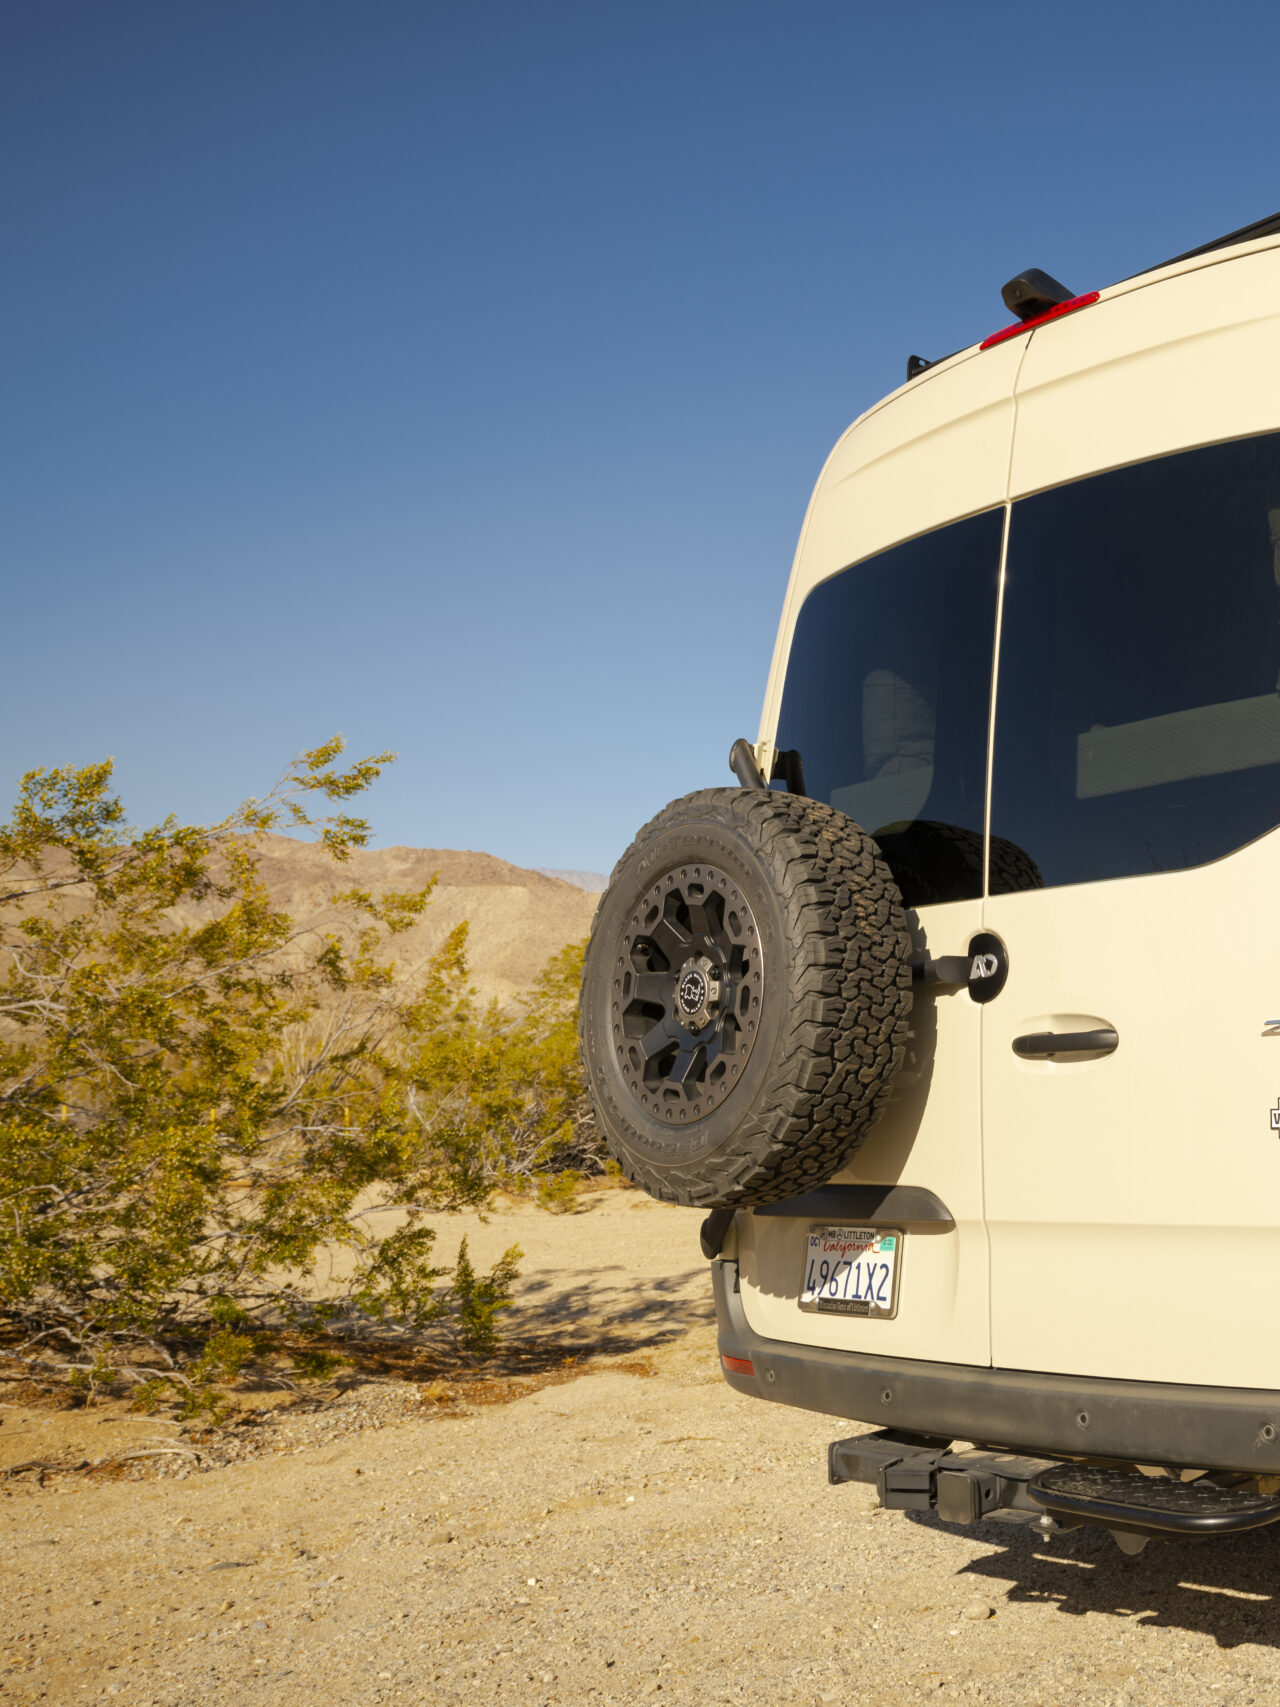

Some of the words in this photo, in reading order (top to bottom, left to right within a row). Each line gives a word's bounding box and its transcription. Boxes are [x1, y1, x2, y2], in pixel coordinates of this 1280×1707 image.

[843, 1231, 875, 1240] LITTLETON
[823, 1240, 880, 1258] California
[806, 1260, 890, 1302] 49671X2
